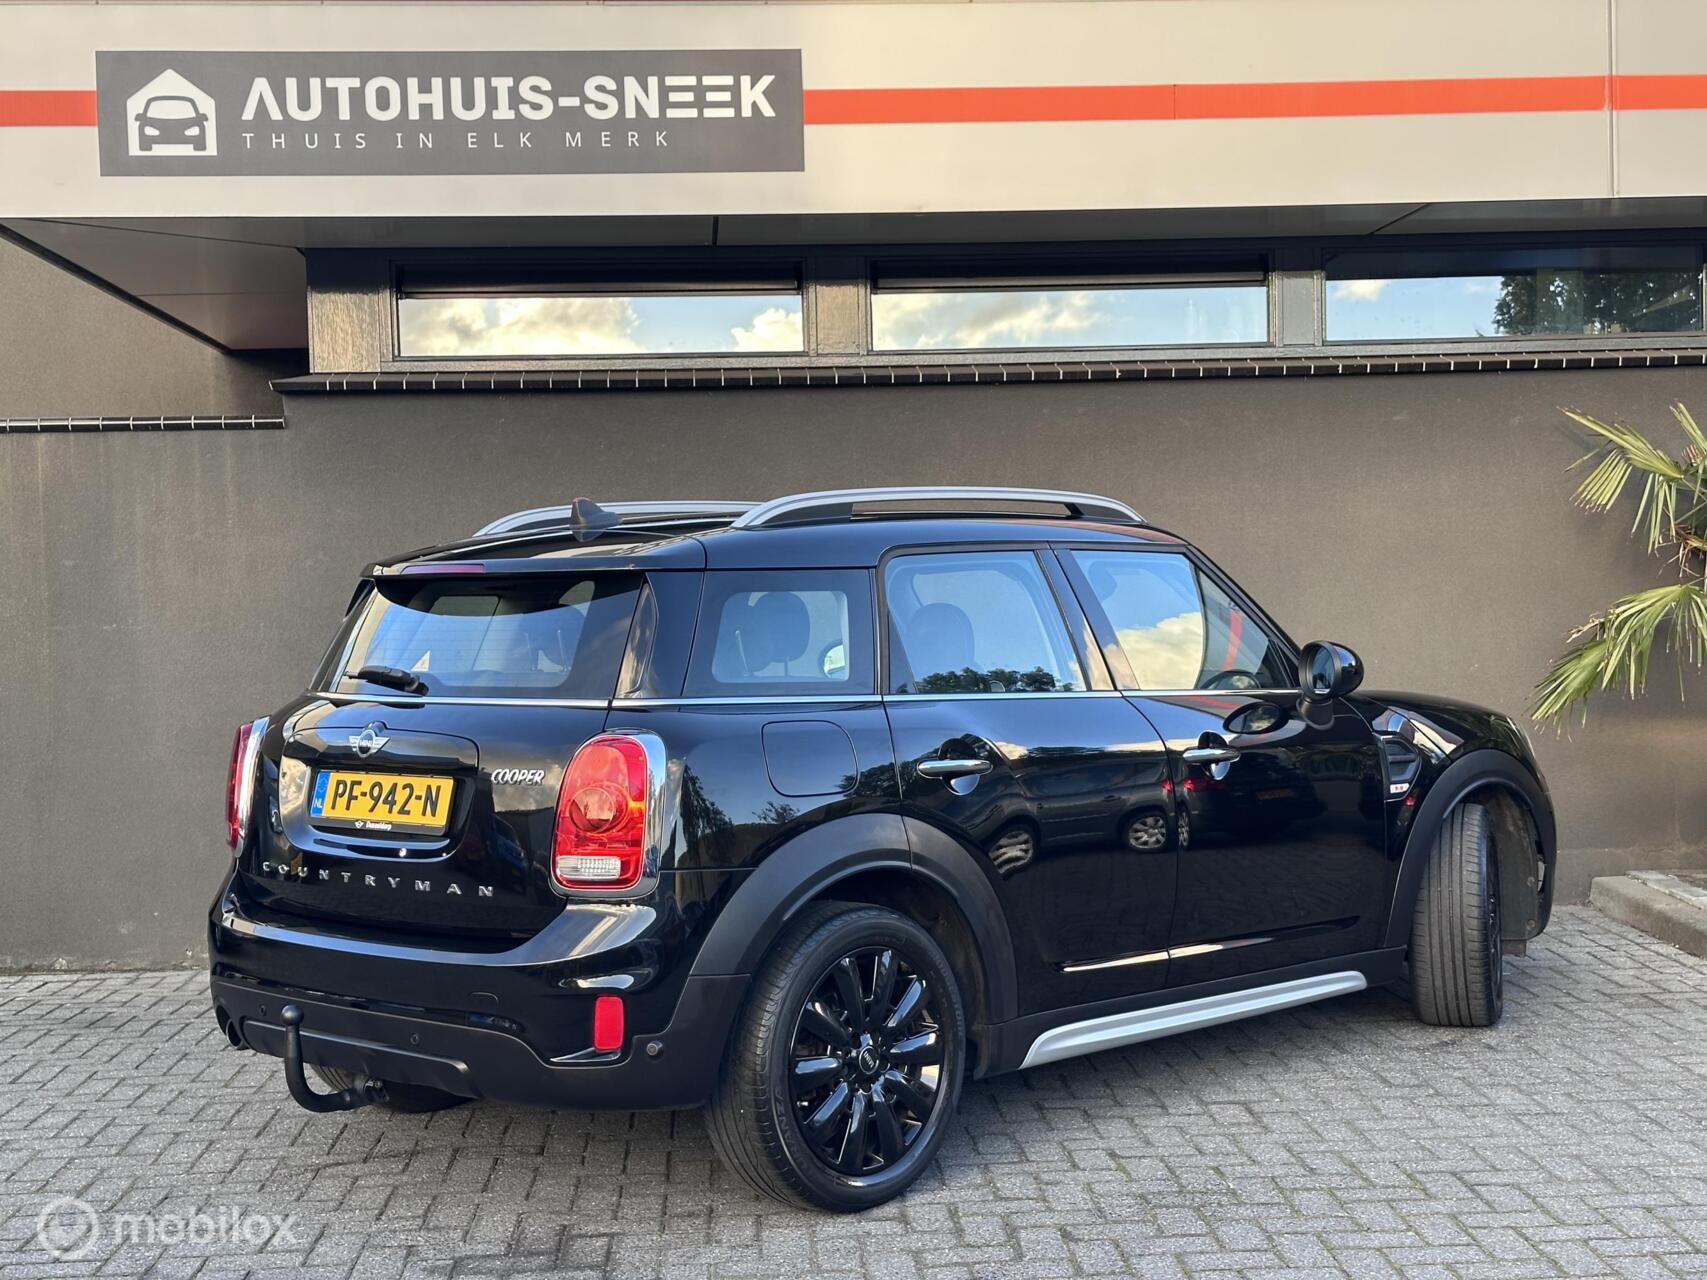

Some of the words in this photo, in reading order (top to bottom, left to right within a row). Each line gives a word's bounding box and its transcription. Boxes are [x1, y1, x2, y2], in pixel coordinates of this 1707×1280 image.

[241, 74, 776, 121] AUTOHUIS-SNEEK
[241, 132, 366, 149] THUIS
[395, 132, 433, 149] IN
[467, 132, 532, 148] ELK
[565, 131, 668, 147] MERK
[490, 768, 545, 785] COOPER
[313, 799, 323, 809] NL
[331, 779, 441, 817] PF-942-N
[262, 861, 494, 897] COUNTRYMAN
